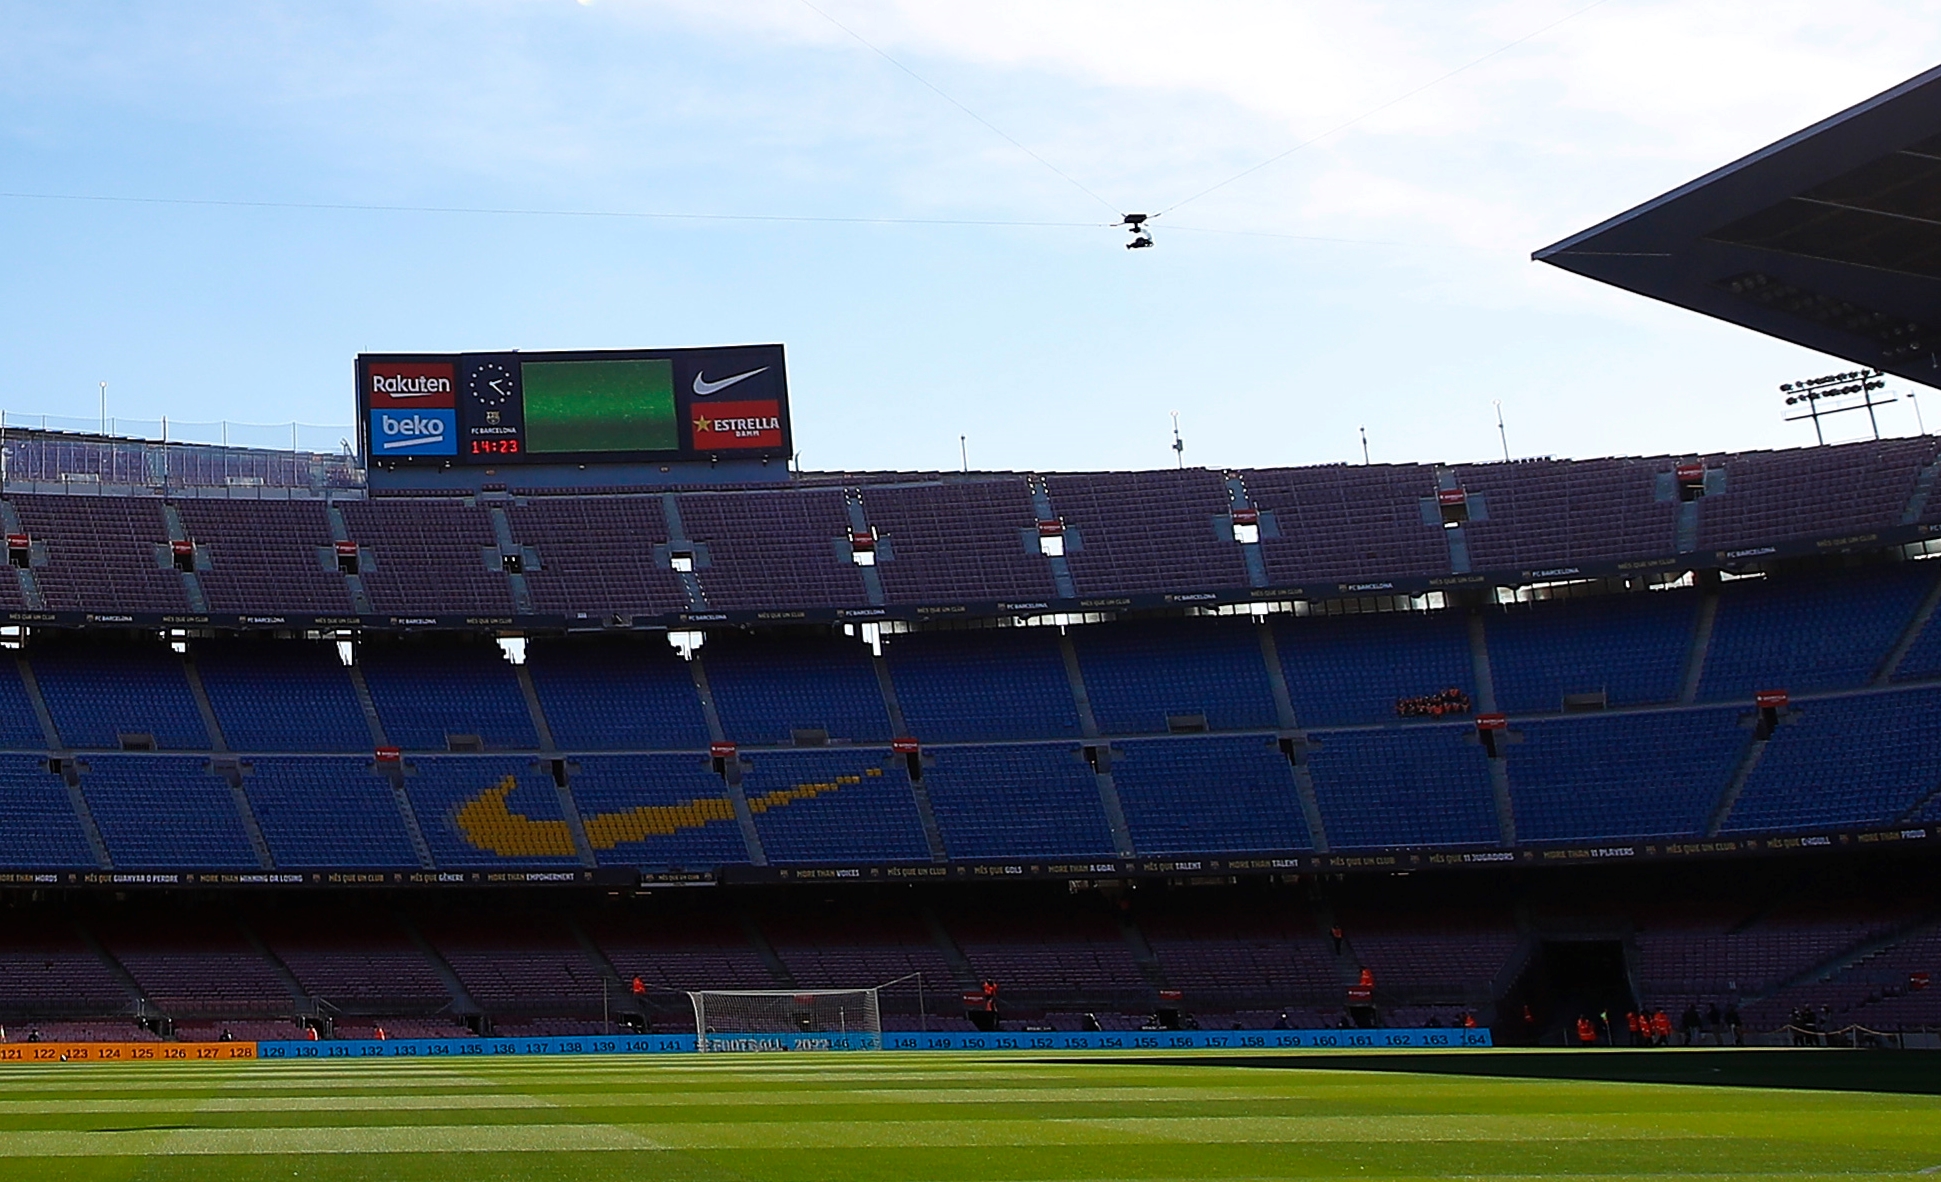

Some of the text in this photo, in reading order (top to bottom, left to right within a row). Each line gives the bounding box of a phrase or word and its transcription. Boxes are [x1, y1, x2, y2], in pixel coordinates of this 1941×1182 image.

[373, 374, 450, 392] Rakuten
[382, 415, 444, 435] beko
[714, 417, 780, 431] ESTRELLA
[472, 440, 518, 453] 14:23
[263, 1041, 681, 1058] 129 130 131 132 133 134 135 136 137 138 139 140 141
[894, 1036, 1486, 1050] 148 149 150 151 152 153 154 155 156 157 158 159 160 161 162 163 164
[1, 1048, 252, 1059] 121 122 123 124 125 126 127 128
